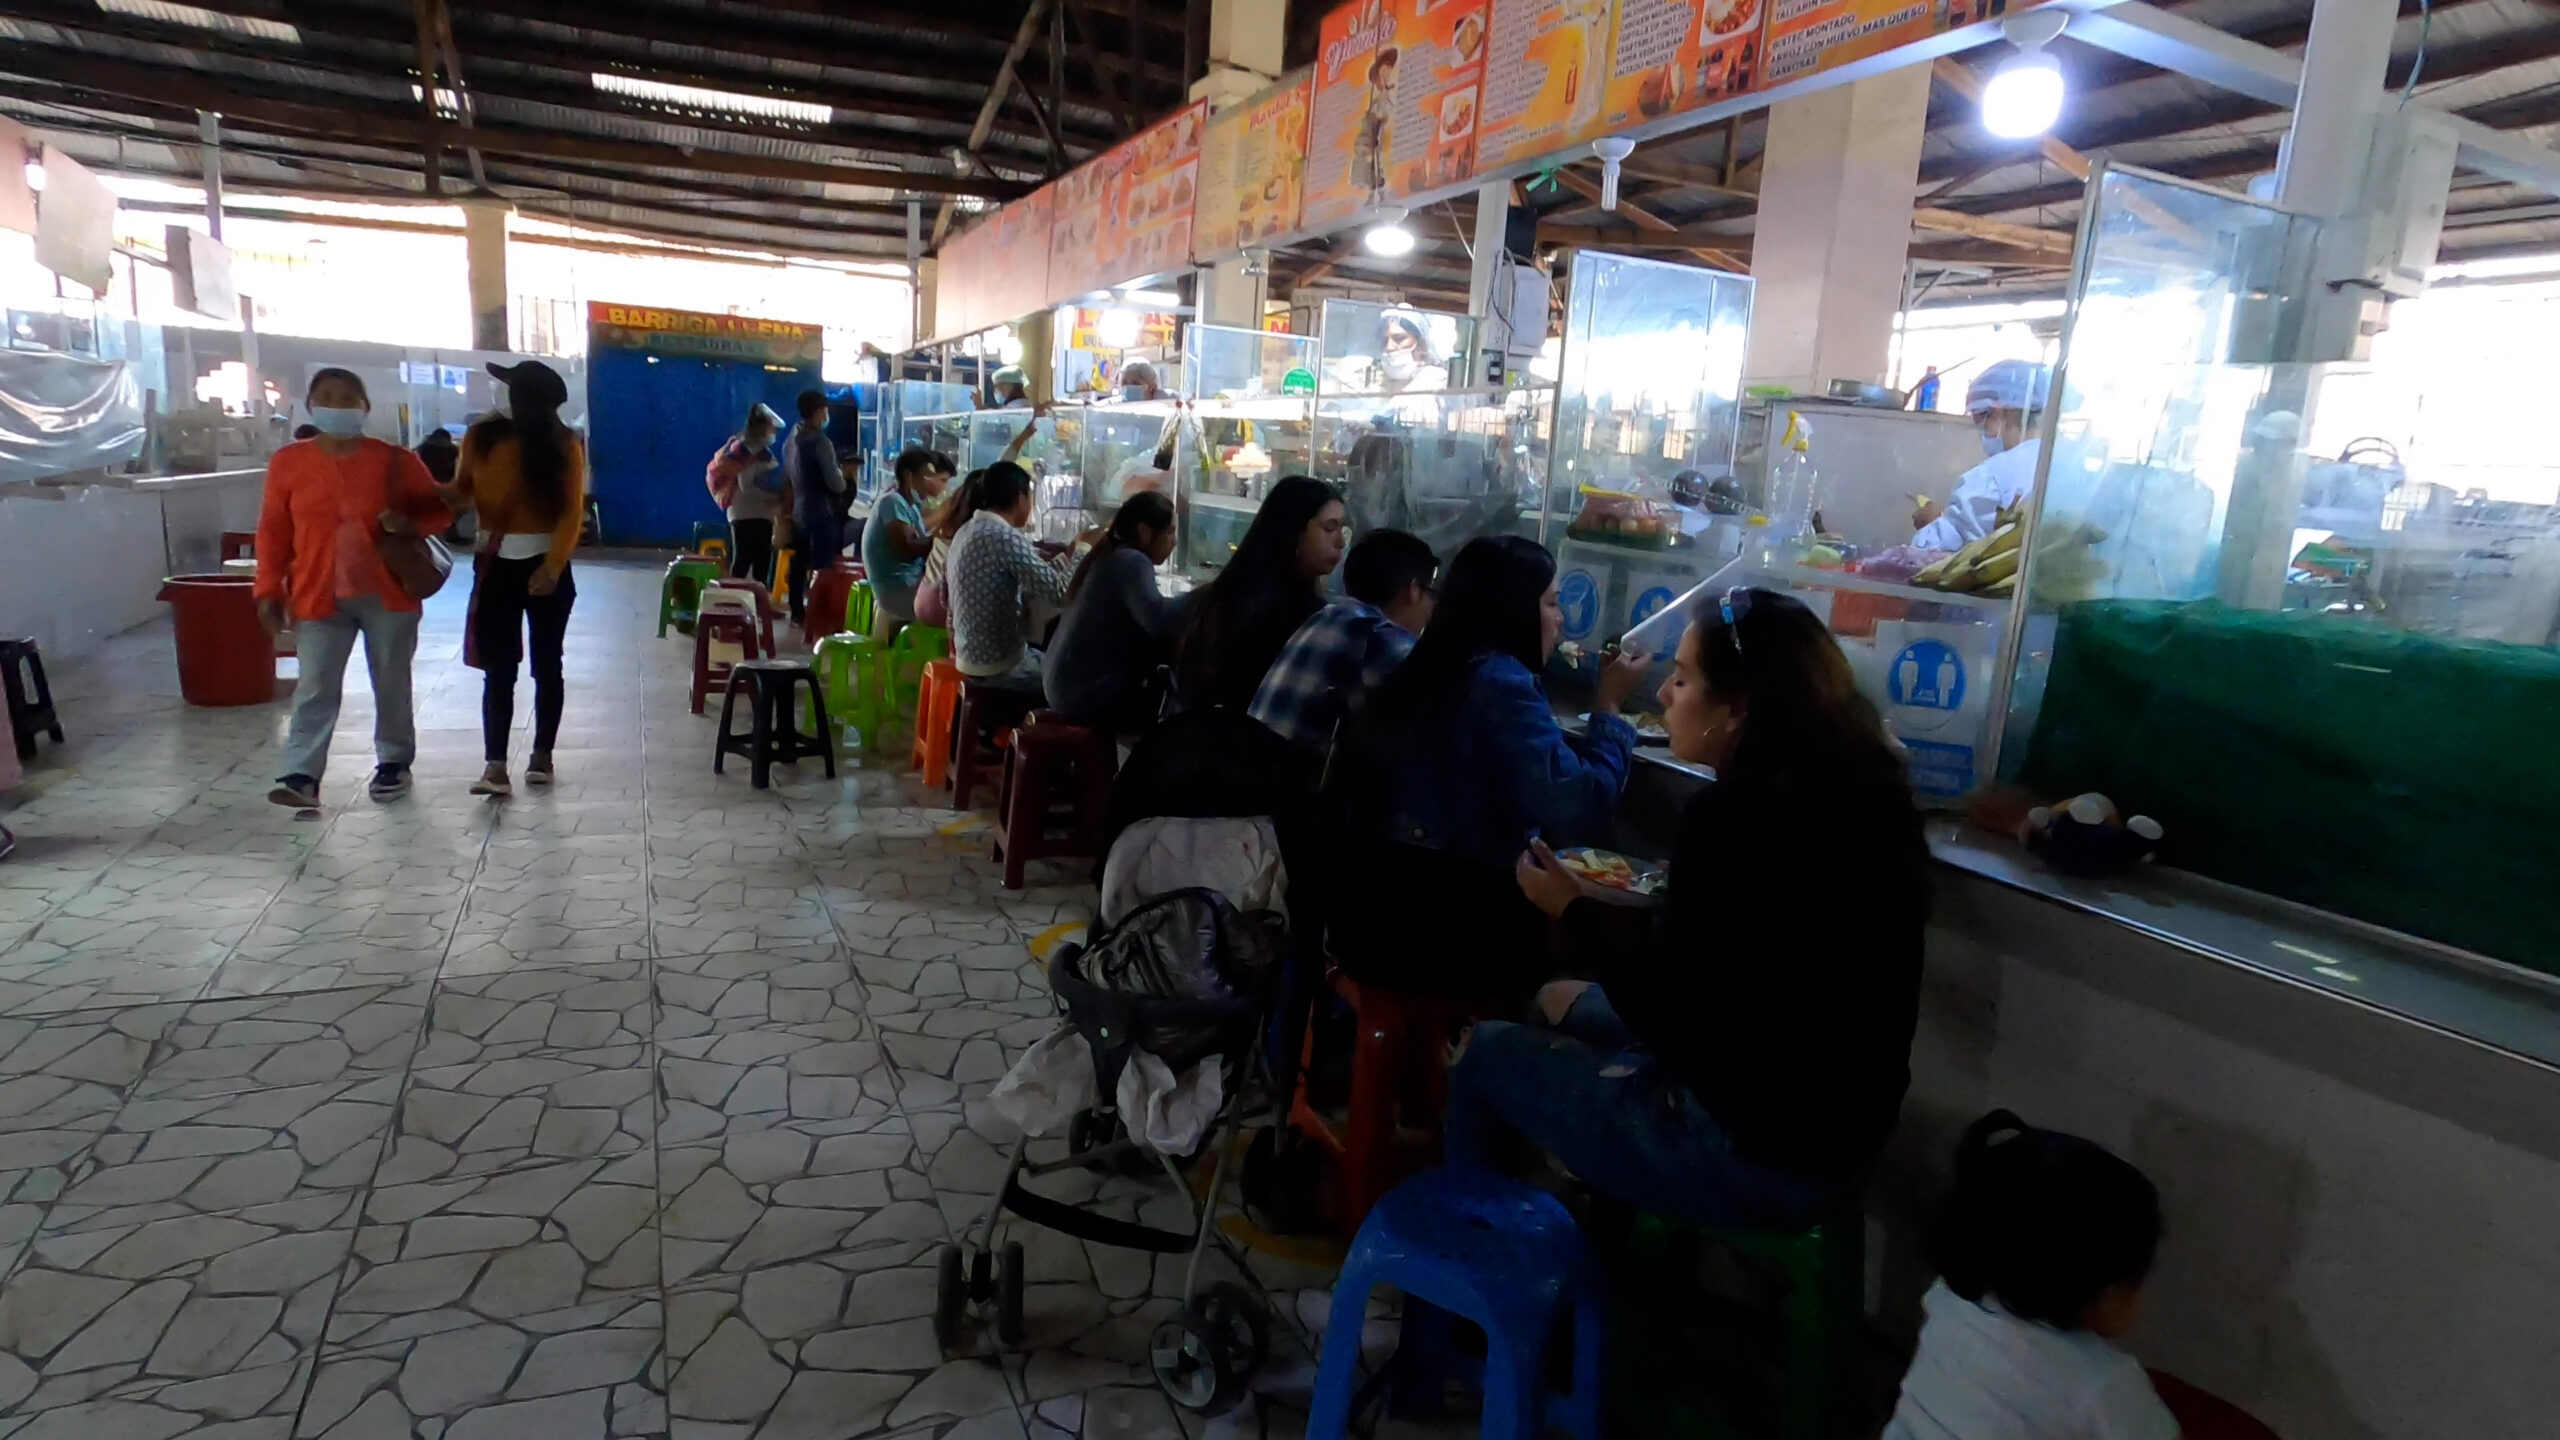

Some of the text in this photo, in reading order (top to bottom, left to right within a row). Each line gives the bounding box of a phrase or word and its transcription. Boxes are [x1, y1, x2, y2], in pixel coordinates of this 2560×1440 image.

[1770, 4, 1927, 63] ARROZ CON HUEVO MAS QUESO
[1772, 14, 1856, 49] BISTEC MONTADO
[1768, 55, 1817, 79] GASEOSAS
[608, 307, 805, 341] BARRIGA LLENA
